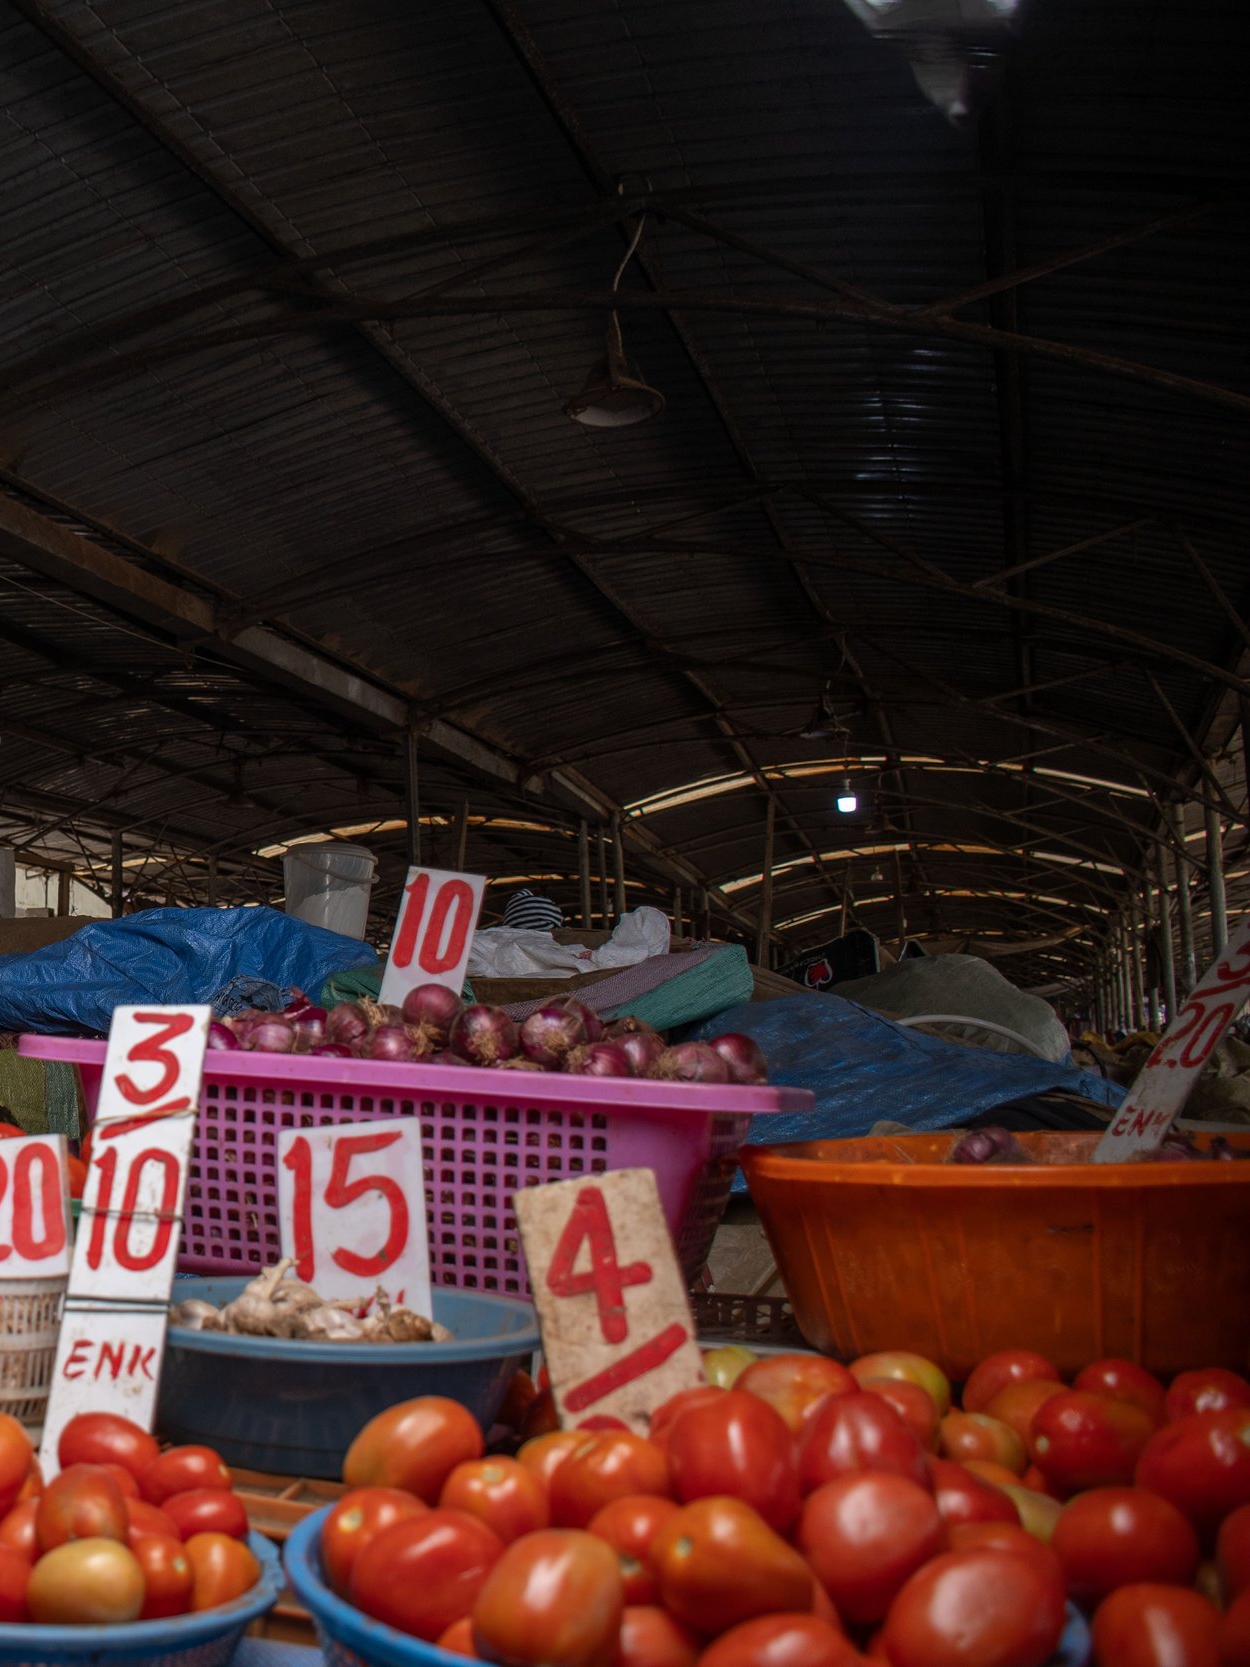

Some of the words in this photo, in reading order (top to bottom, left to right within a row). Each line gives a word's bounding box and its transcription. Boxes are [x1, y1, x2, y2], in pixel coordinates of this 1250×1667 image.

[393, 872, 474, 975] 10
[1145, 1002, 1235, 1068] 20
[87, 1147, 180, 1272] 10
[283, 1130, 410, 1284] 15
[63, 1339, 156, 1381] ENK
